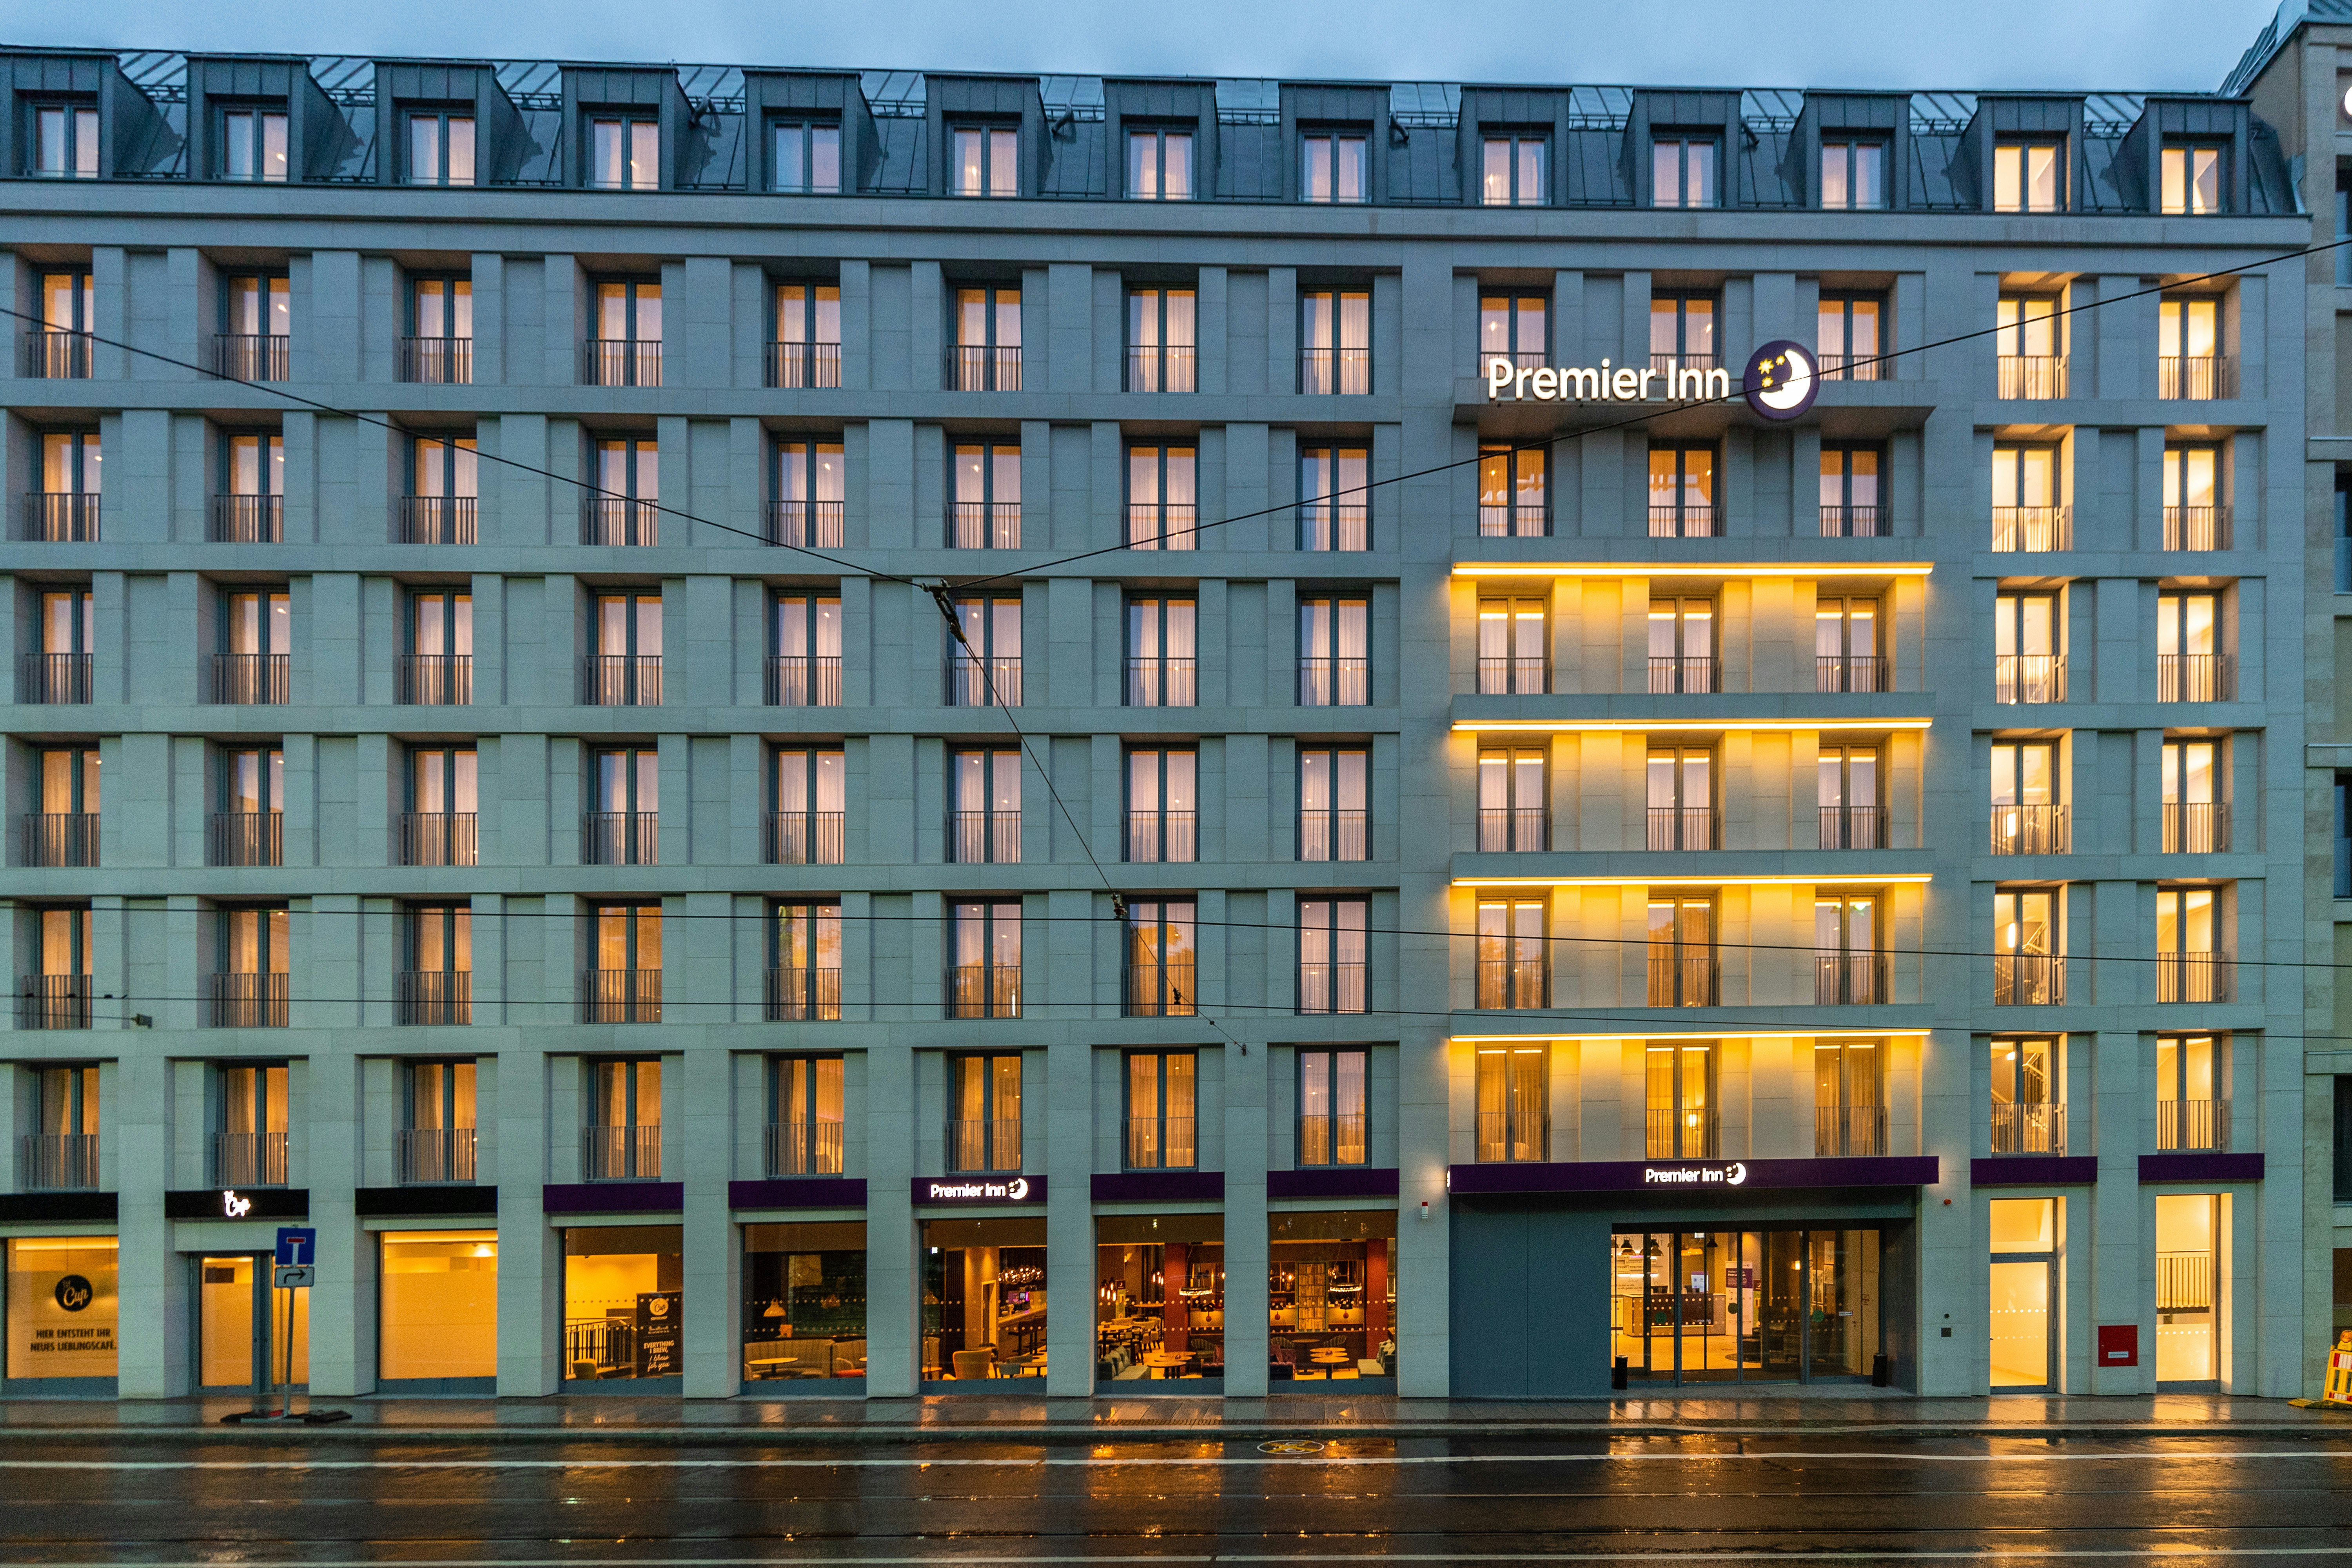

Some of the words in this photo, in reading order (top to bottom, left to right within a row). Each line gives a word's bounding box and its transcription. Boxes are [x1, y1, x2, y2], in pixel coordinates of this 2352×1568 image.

[1489, 358, 1657, 399] Premier
[1668, 359, 1730, 399] Inn
[1645, 1168, 1700, 1183] Premier
[1702, 1167, 1724, 1182] Inn
[930, 1183, 984, 1198] Premier
[985, 1183, 1006, 1197] Inn
[64, 1287, 89, 1306] Cup
[36, 1329, 54, 1339] HIER
[57, 1328, 94, 1339] ENTSTEHT
[97, 1328, 111, 1338] IHR
[31, 1342, 55, 1352] NEUES
[644, 1340, 675, 1349] EVERYTHING
[658, 1362, 671, 1372] you
